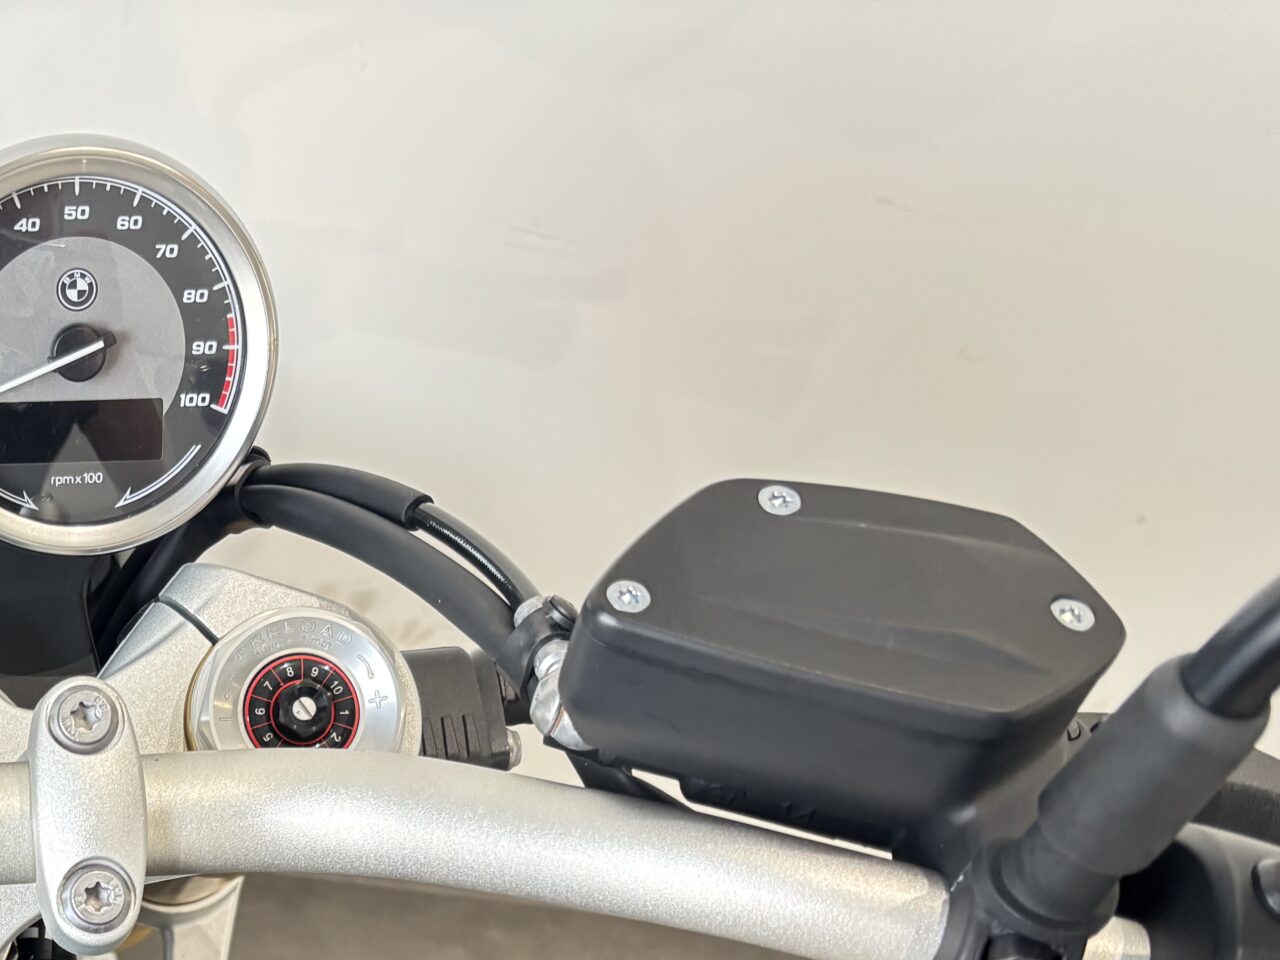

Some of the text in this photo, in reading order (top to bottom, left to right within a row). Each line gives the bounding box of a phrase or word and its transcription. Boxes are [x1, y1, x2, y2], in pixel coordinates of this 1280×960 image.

[64, 206, 89, 220] 50
[14, 218, 40, 232] 40
[116, 216, 143, 230] 60
[155, 244, 179, 258] 70
[63, 271, 91, 284] BMW
[182, 289, 209, 303] 80
[191, 341, 217, 355] 90
[179, 393, 210, 408] 100
[235, 620, 352, 664] PRELOAD
[286, 666, 295, 677] 8
[310, 666, 319, 677] 9
[263, 680, 273, 691] 7
[330, 680, 344, 695] 10
[255, 707, 266, 715] 6
[263, 732, 274, 742] 5
[330, 732, 342, 742] 2
